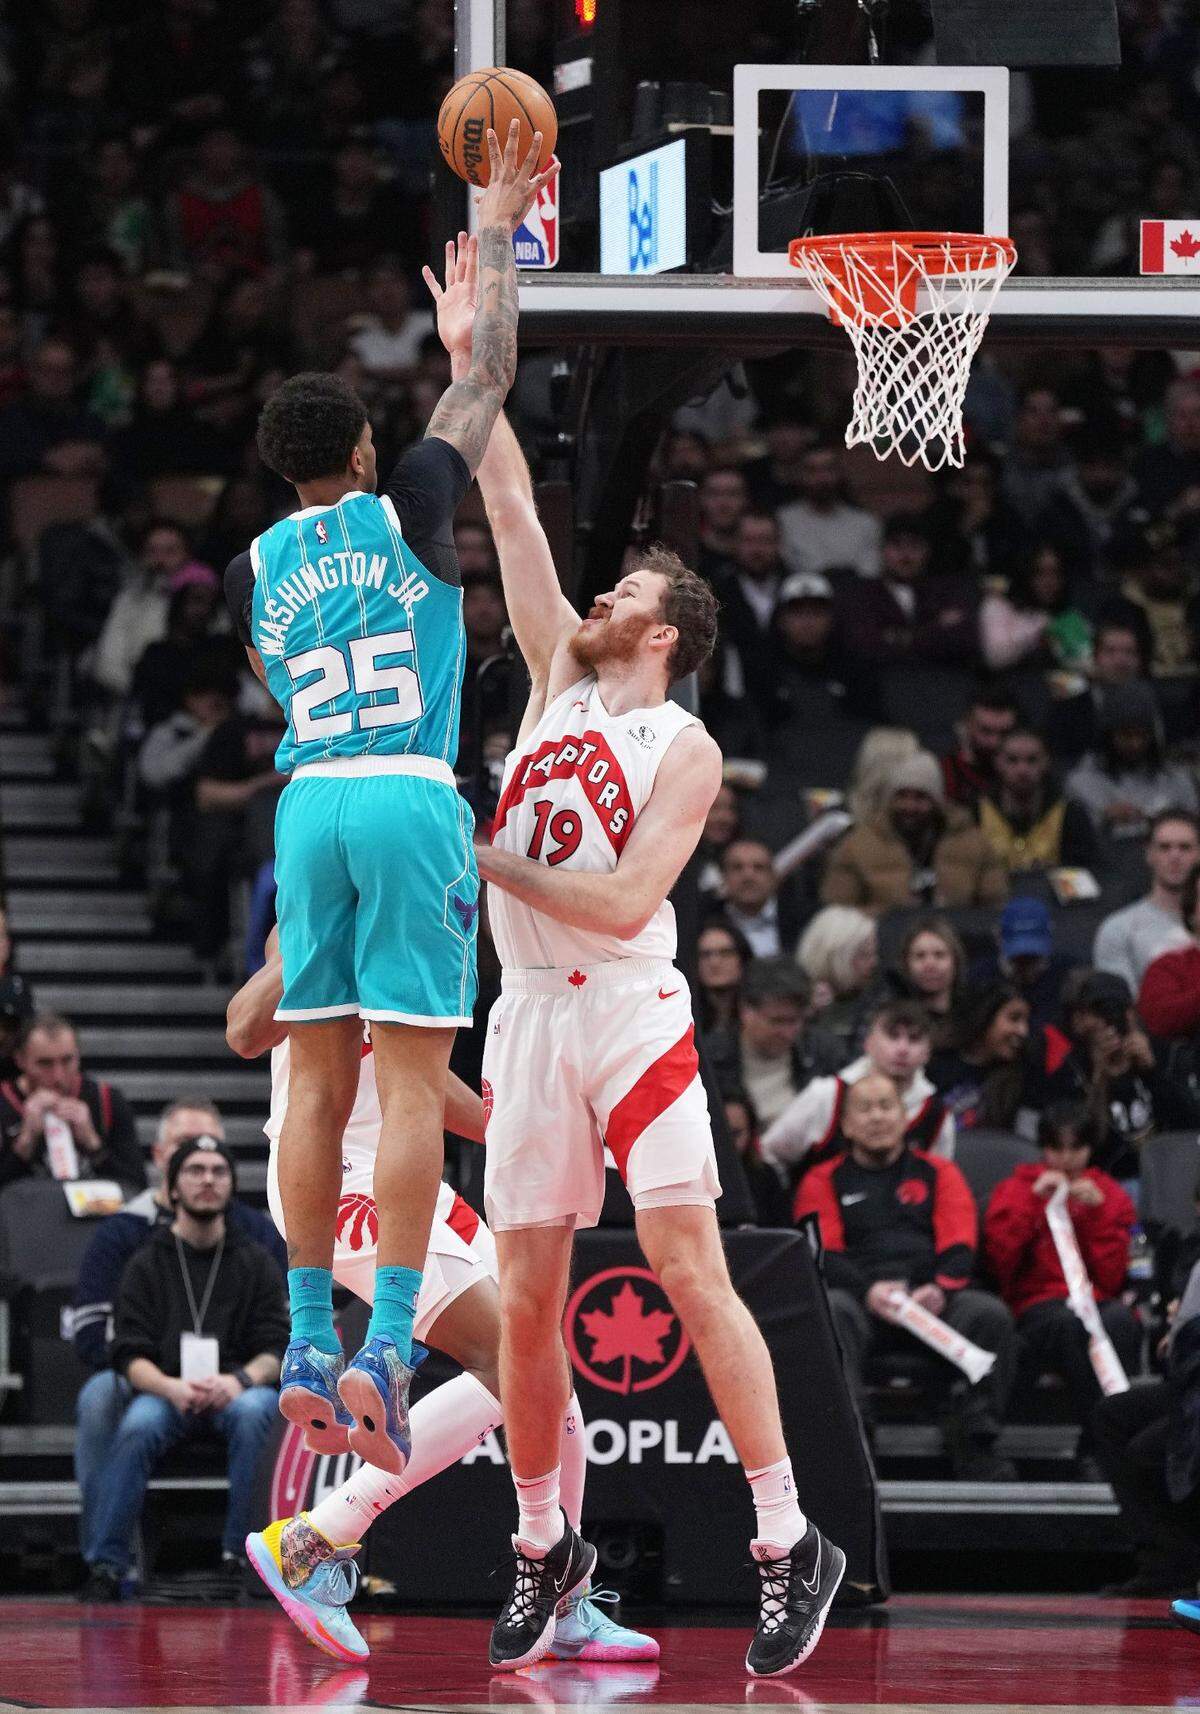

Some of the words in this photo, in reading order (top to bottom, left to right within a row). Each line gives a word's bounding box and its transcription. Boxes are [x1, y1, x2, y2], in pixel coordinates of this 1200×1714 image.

[515, 242, 540, 261] NBA
[259, 552, 388, 656] WASHINGTON
[387, 572, 430, 618] JR
[284, 629, 425, 744] 25
[526, 799, 583, 867] 19
[461, 1418, 739, 1465] AOPLA
